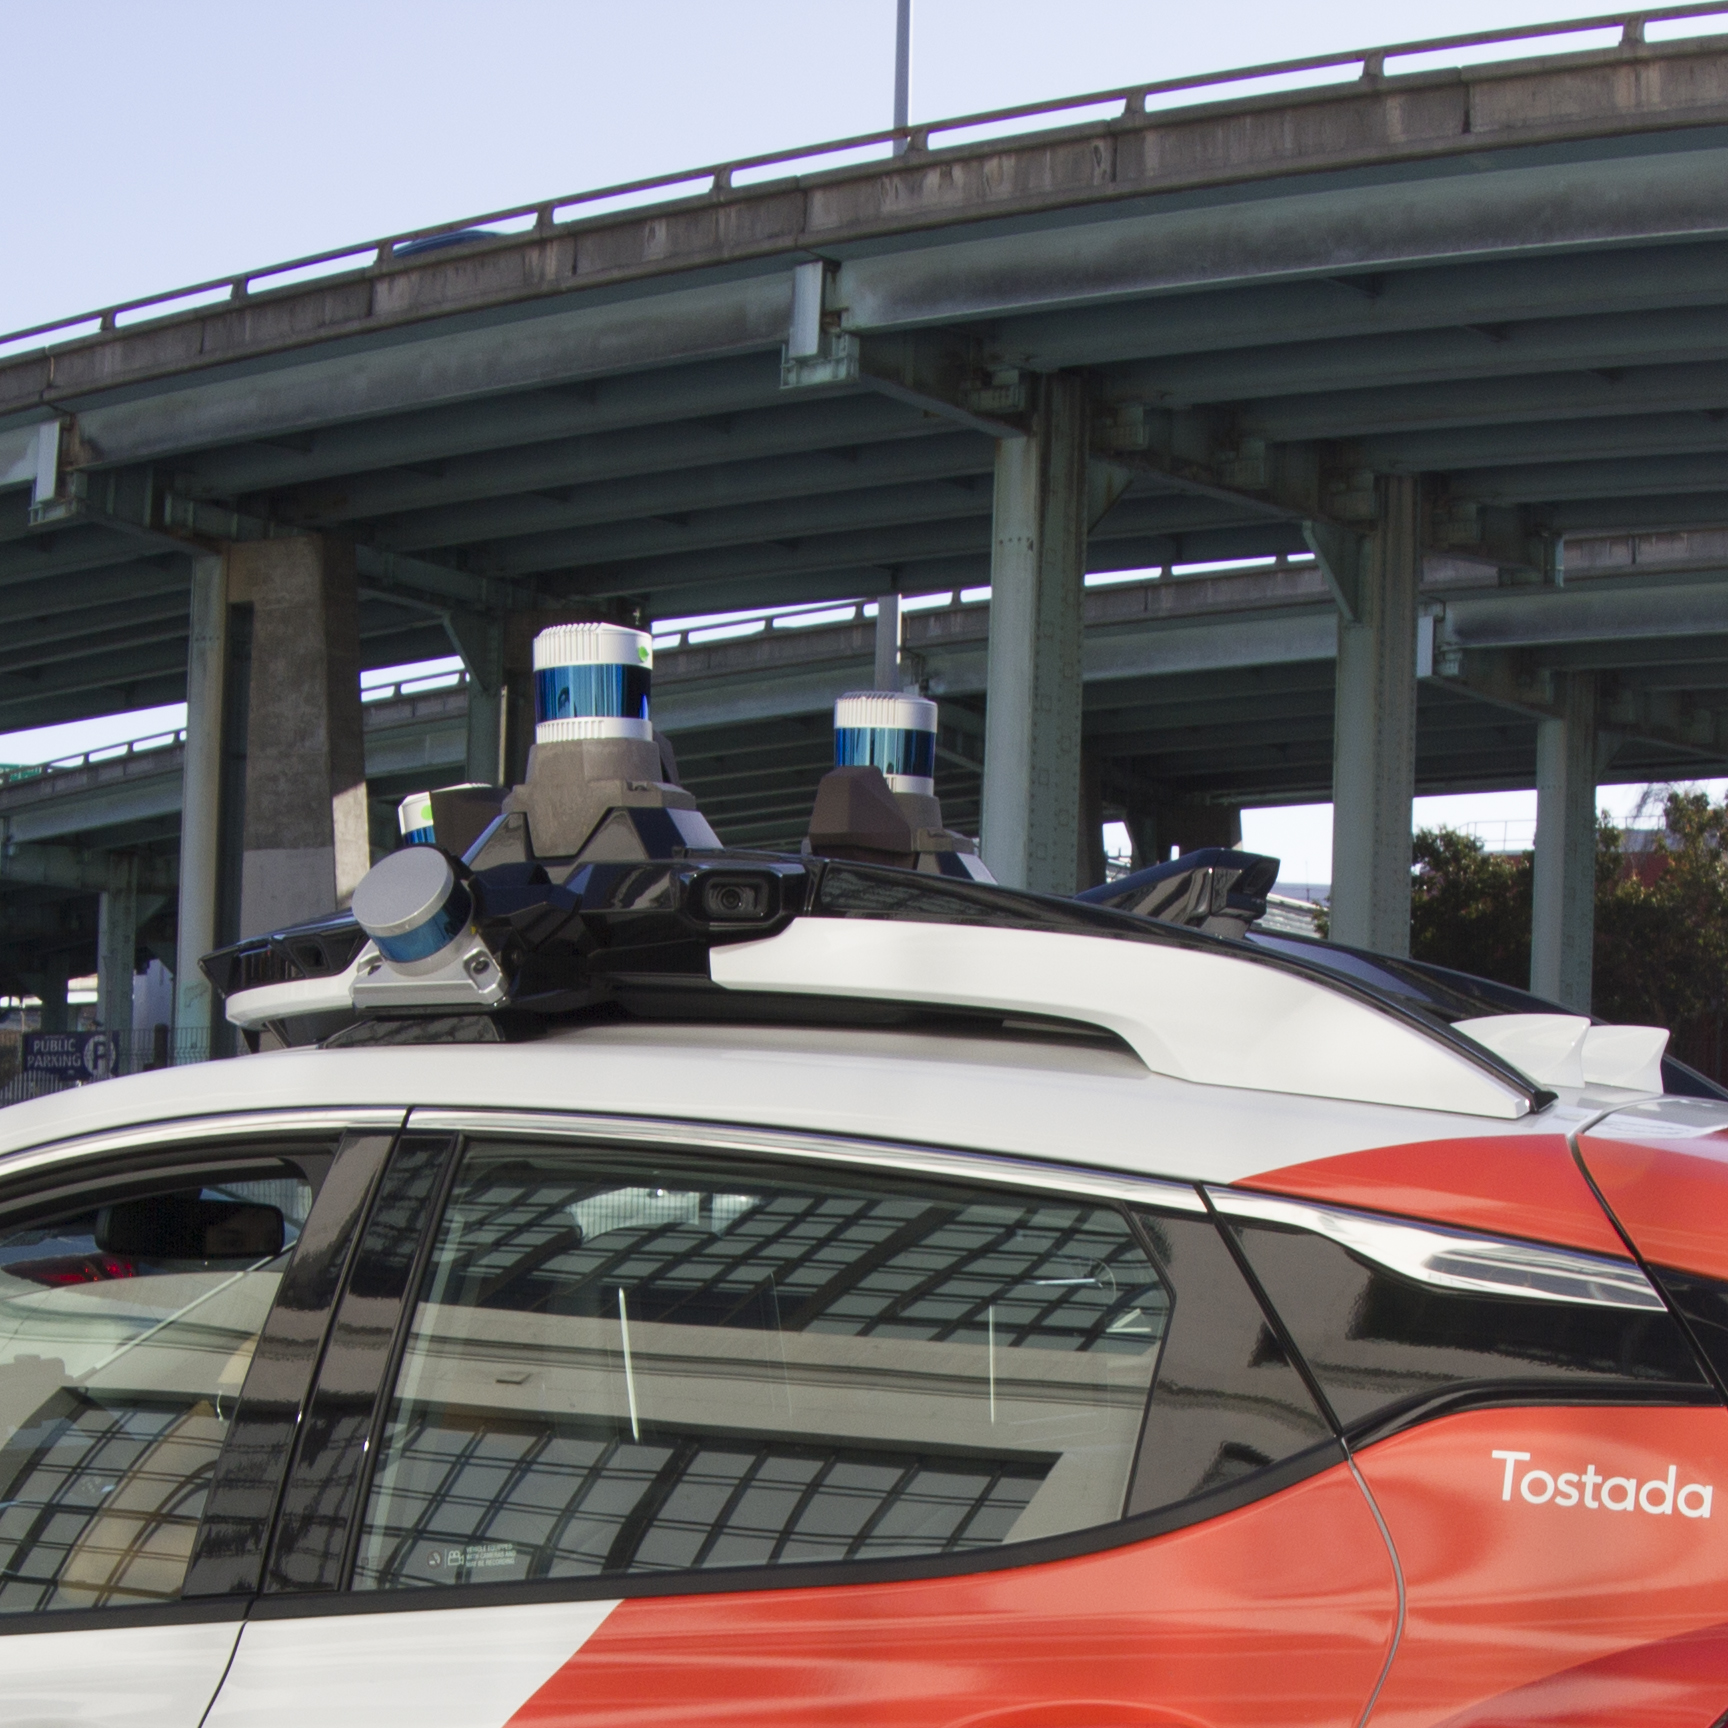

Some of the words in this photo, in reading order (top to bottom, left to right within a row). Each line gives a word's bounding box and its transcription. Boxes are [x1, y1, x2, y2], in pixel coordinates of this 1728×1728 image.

[33, 1038, 76, 1053] PUBLIC
[27, 1053, 82, 1068] PARKING
[1490, 1449, 1714, 1518] Tostada
